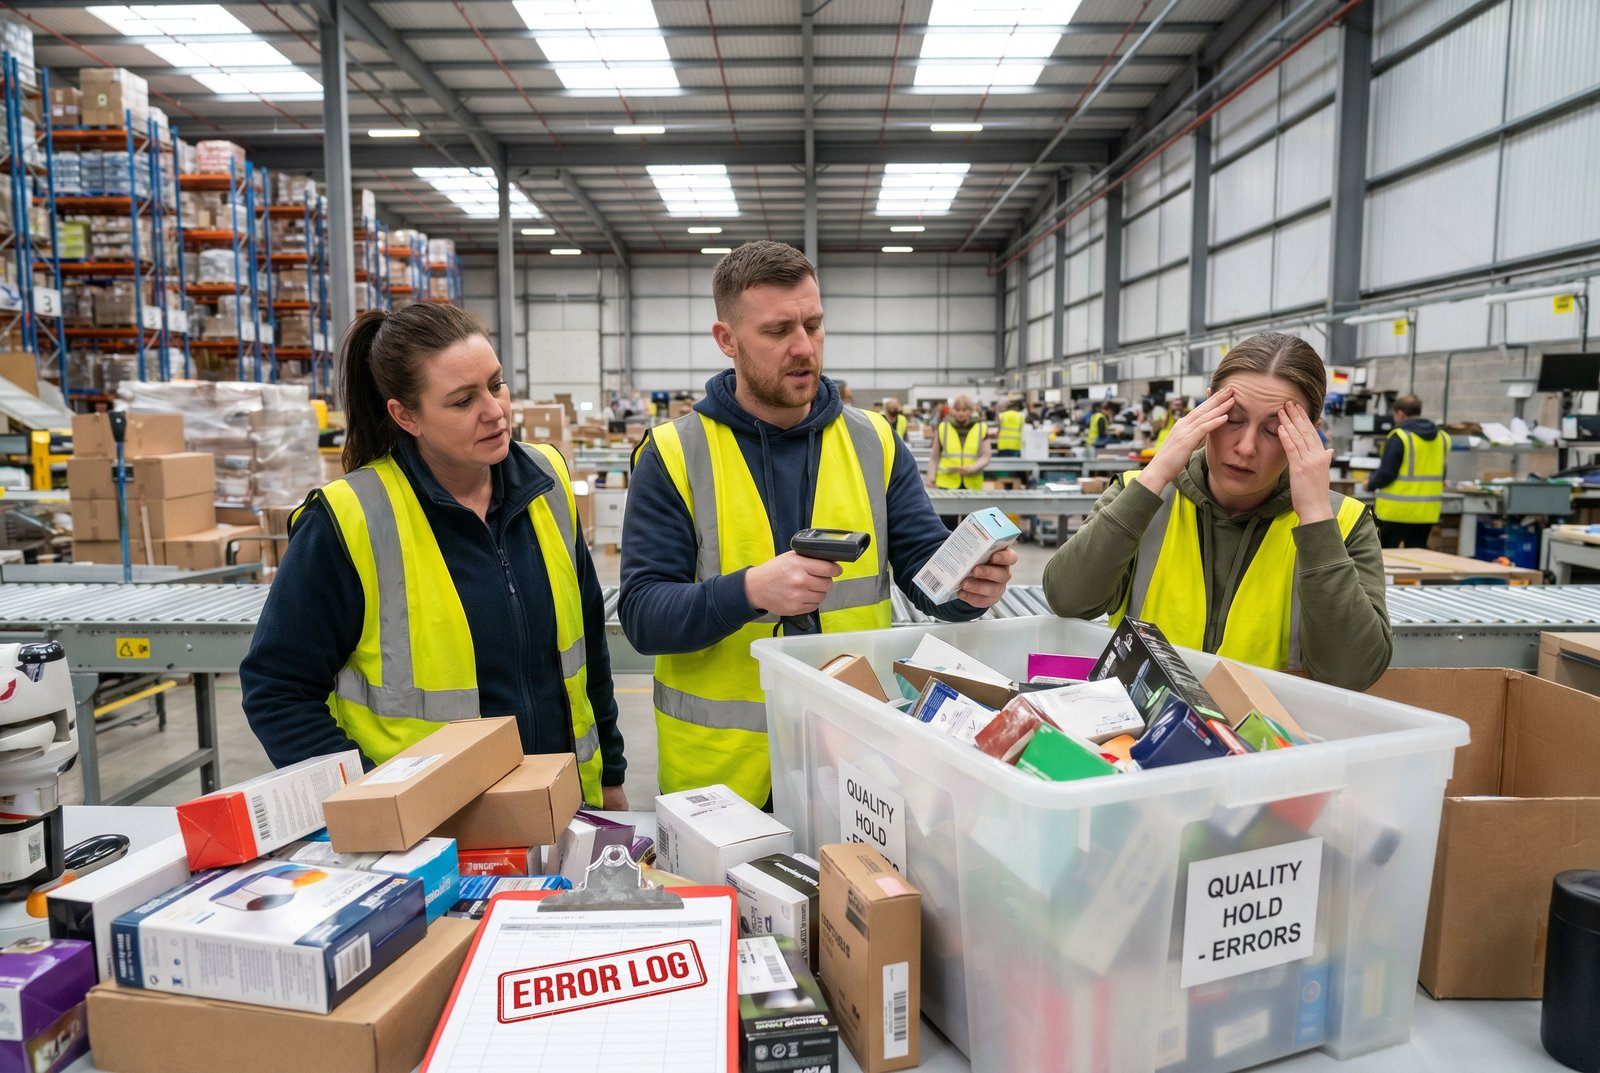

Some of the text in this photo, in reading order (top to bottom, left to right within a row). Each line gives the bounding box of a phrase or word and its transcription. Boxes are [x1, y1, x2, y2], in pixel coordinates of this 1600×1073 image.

[43, 295, 53, 313] 3
[846, 778, 895, 824] QUALITY
[855, 810, 887, 847] HOLD
[1207, 860, 1303, 899] QUALITY
[1222, 896, 1283, 928] HOLD
[1212, 922, 1301, 962] ERRORS
[513, 964, 622, 1010] ERROR
[628, 951, 690, 987] LOG
